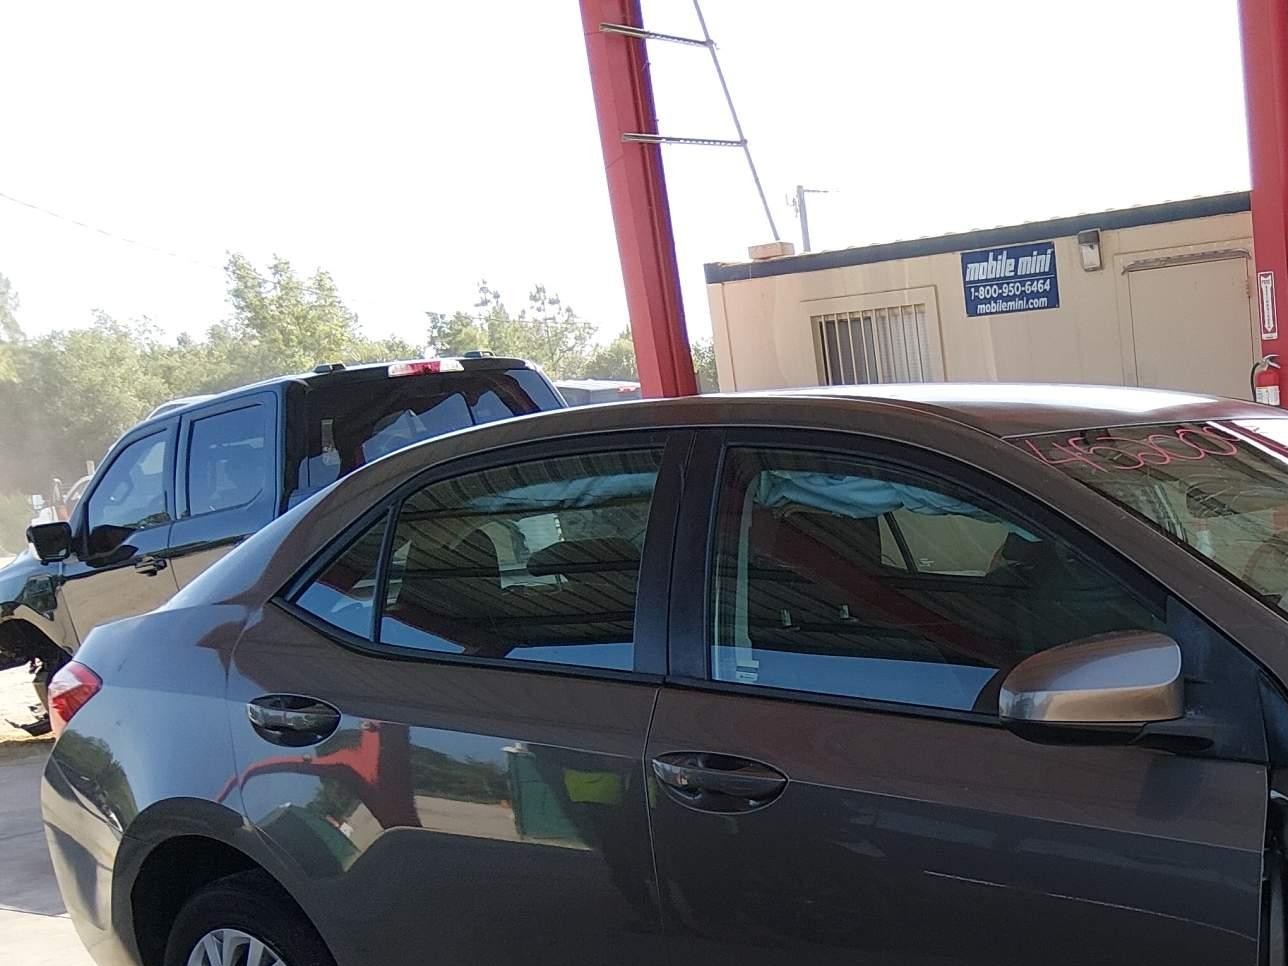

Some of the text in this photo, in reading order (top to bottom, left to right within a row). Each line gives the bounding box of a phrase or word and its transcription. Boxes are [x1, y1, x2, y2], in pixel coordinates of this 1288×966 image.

[966, 248, 1052, 281] mobile mini
[970, 279, 1051, 300] 1-800-950-6464
[977, 297, 1048, 314] mobilemini.com
